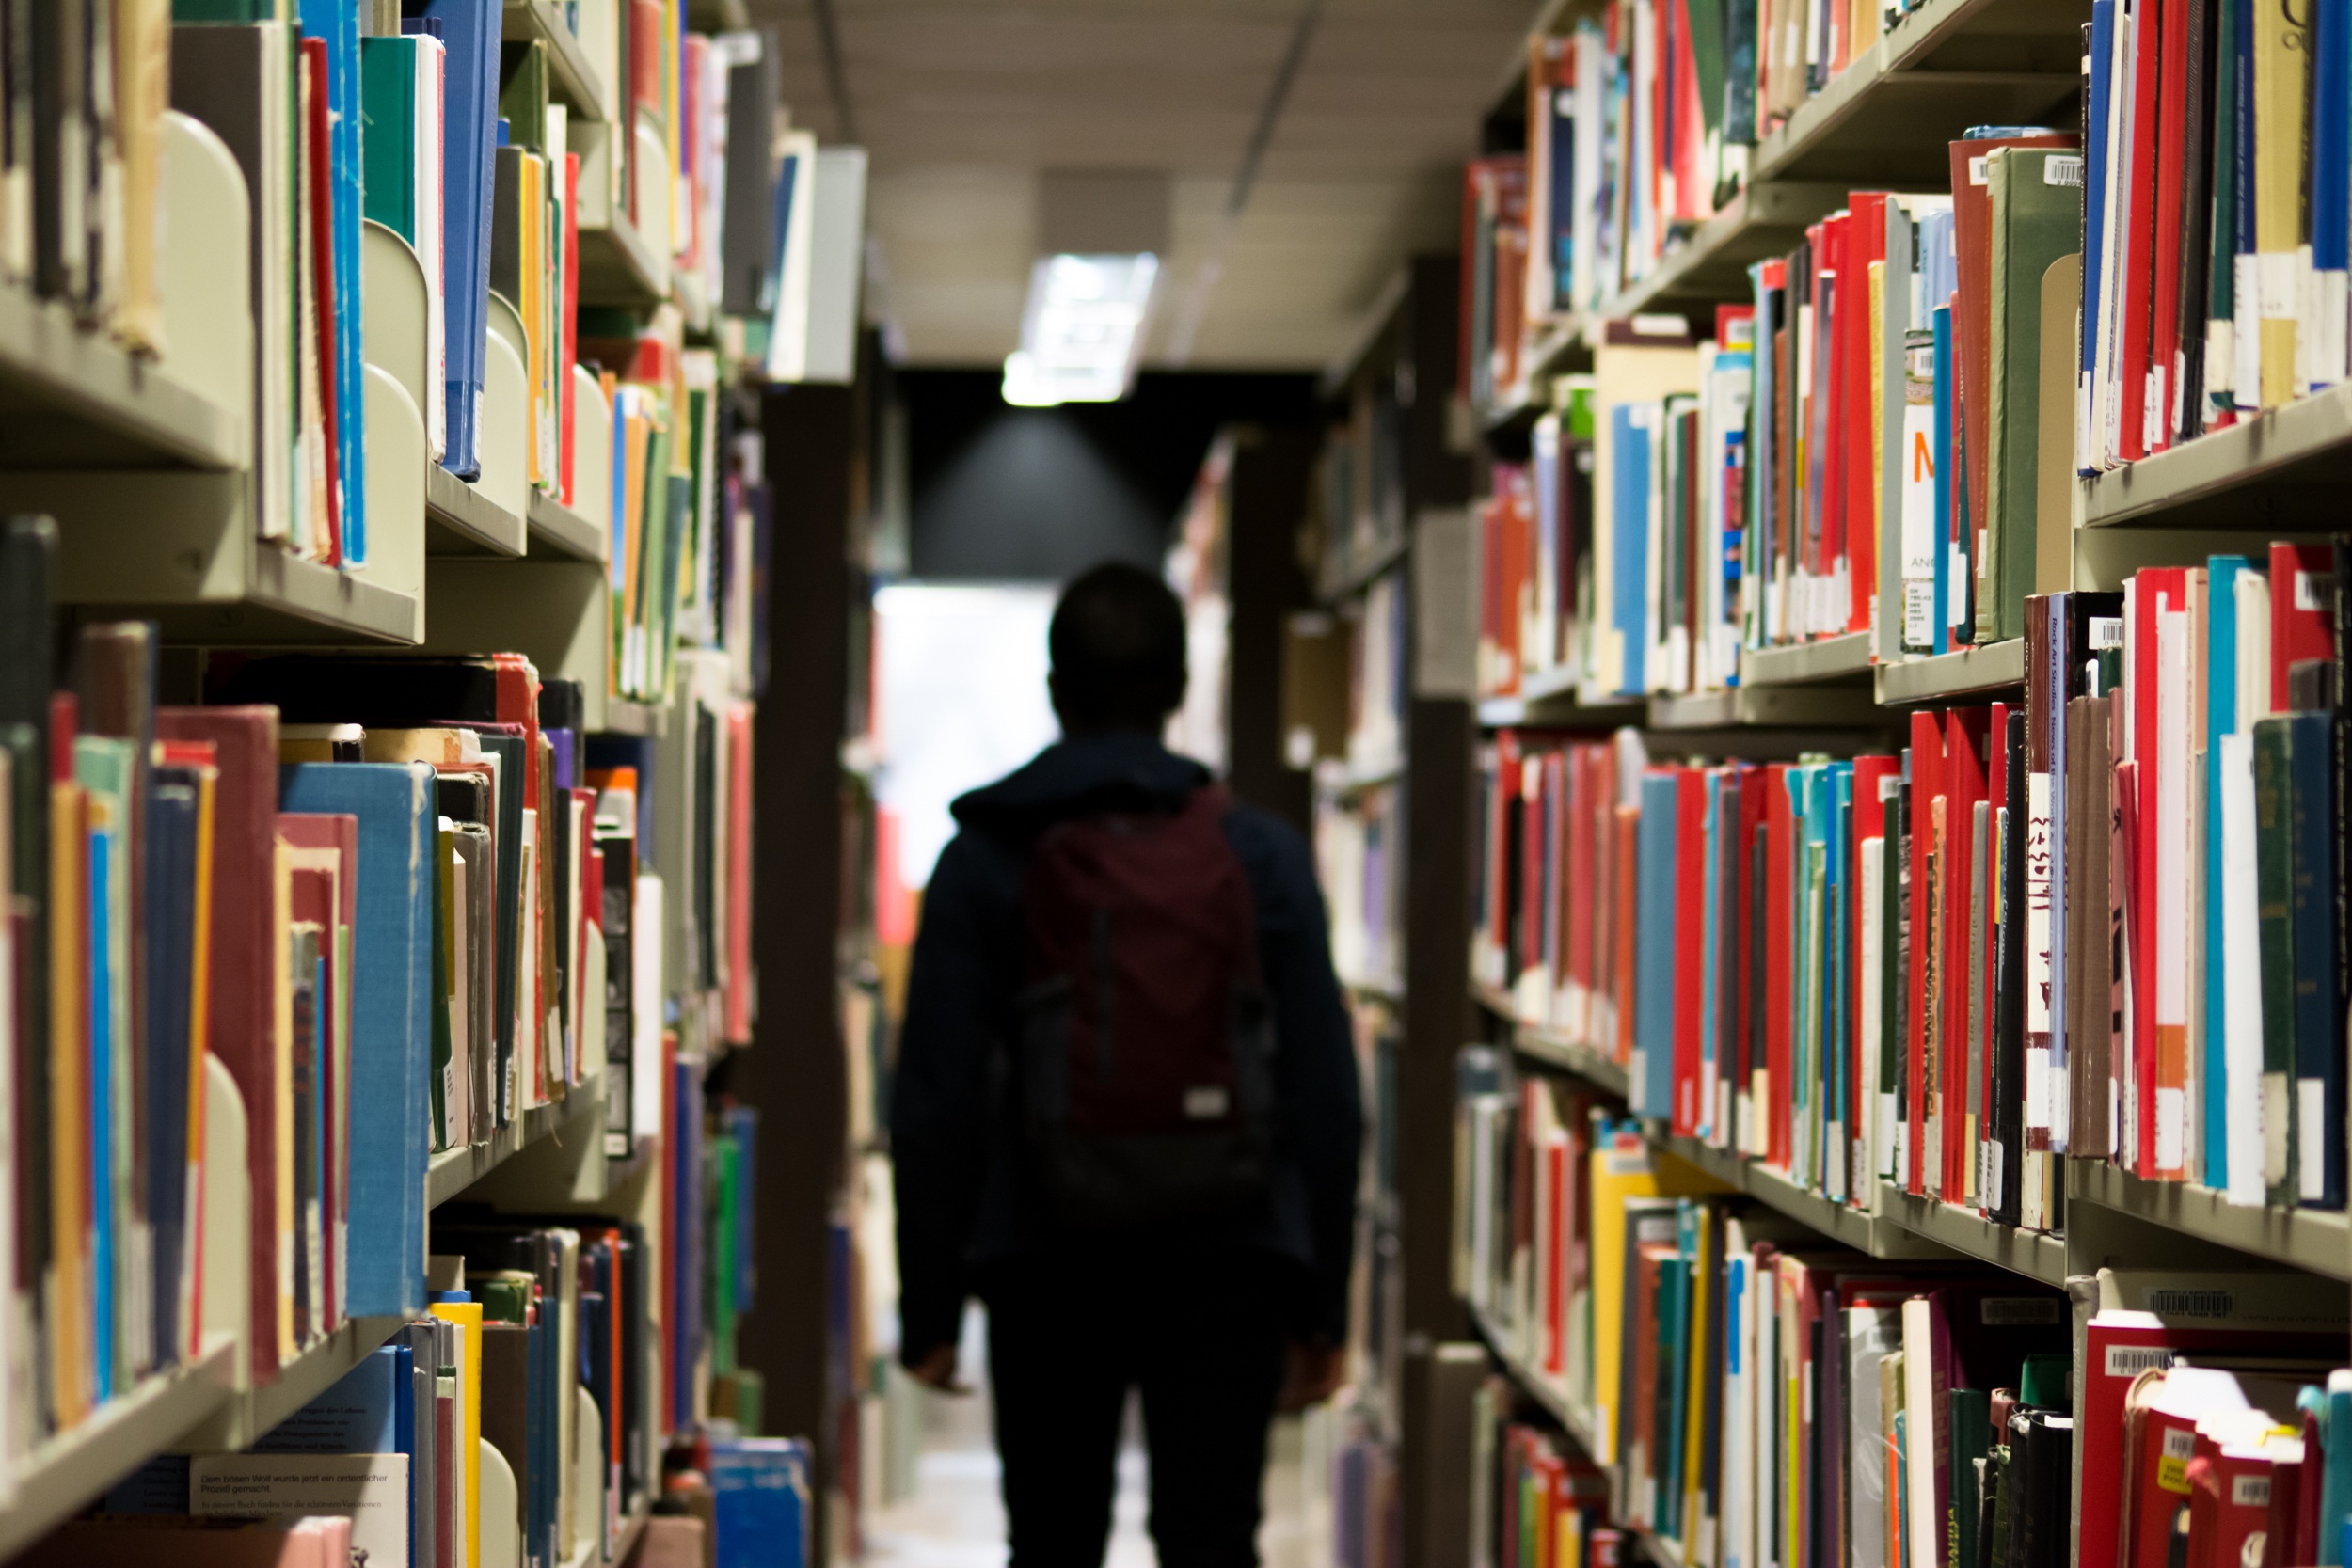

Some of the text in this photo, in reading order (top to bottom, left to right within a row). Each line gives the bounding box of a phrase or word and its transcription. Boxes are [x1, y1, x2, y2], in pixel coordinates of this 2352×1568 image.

[2051, 752, 2056, 766] of
[200, 1474, 388, 1484] Dem bösen Wolf wurde jetzt ein ordentlicher
[200, 1484, 272, 1495] Prozeß gemacht.
[306, 1500, 342, 1509] schönsten
